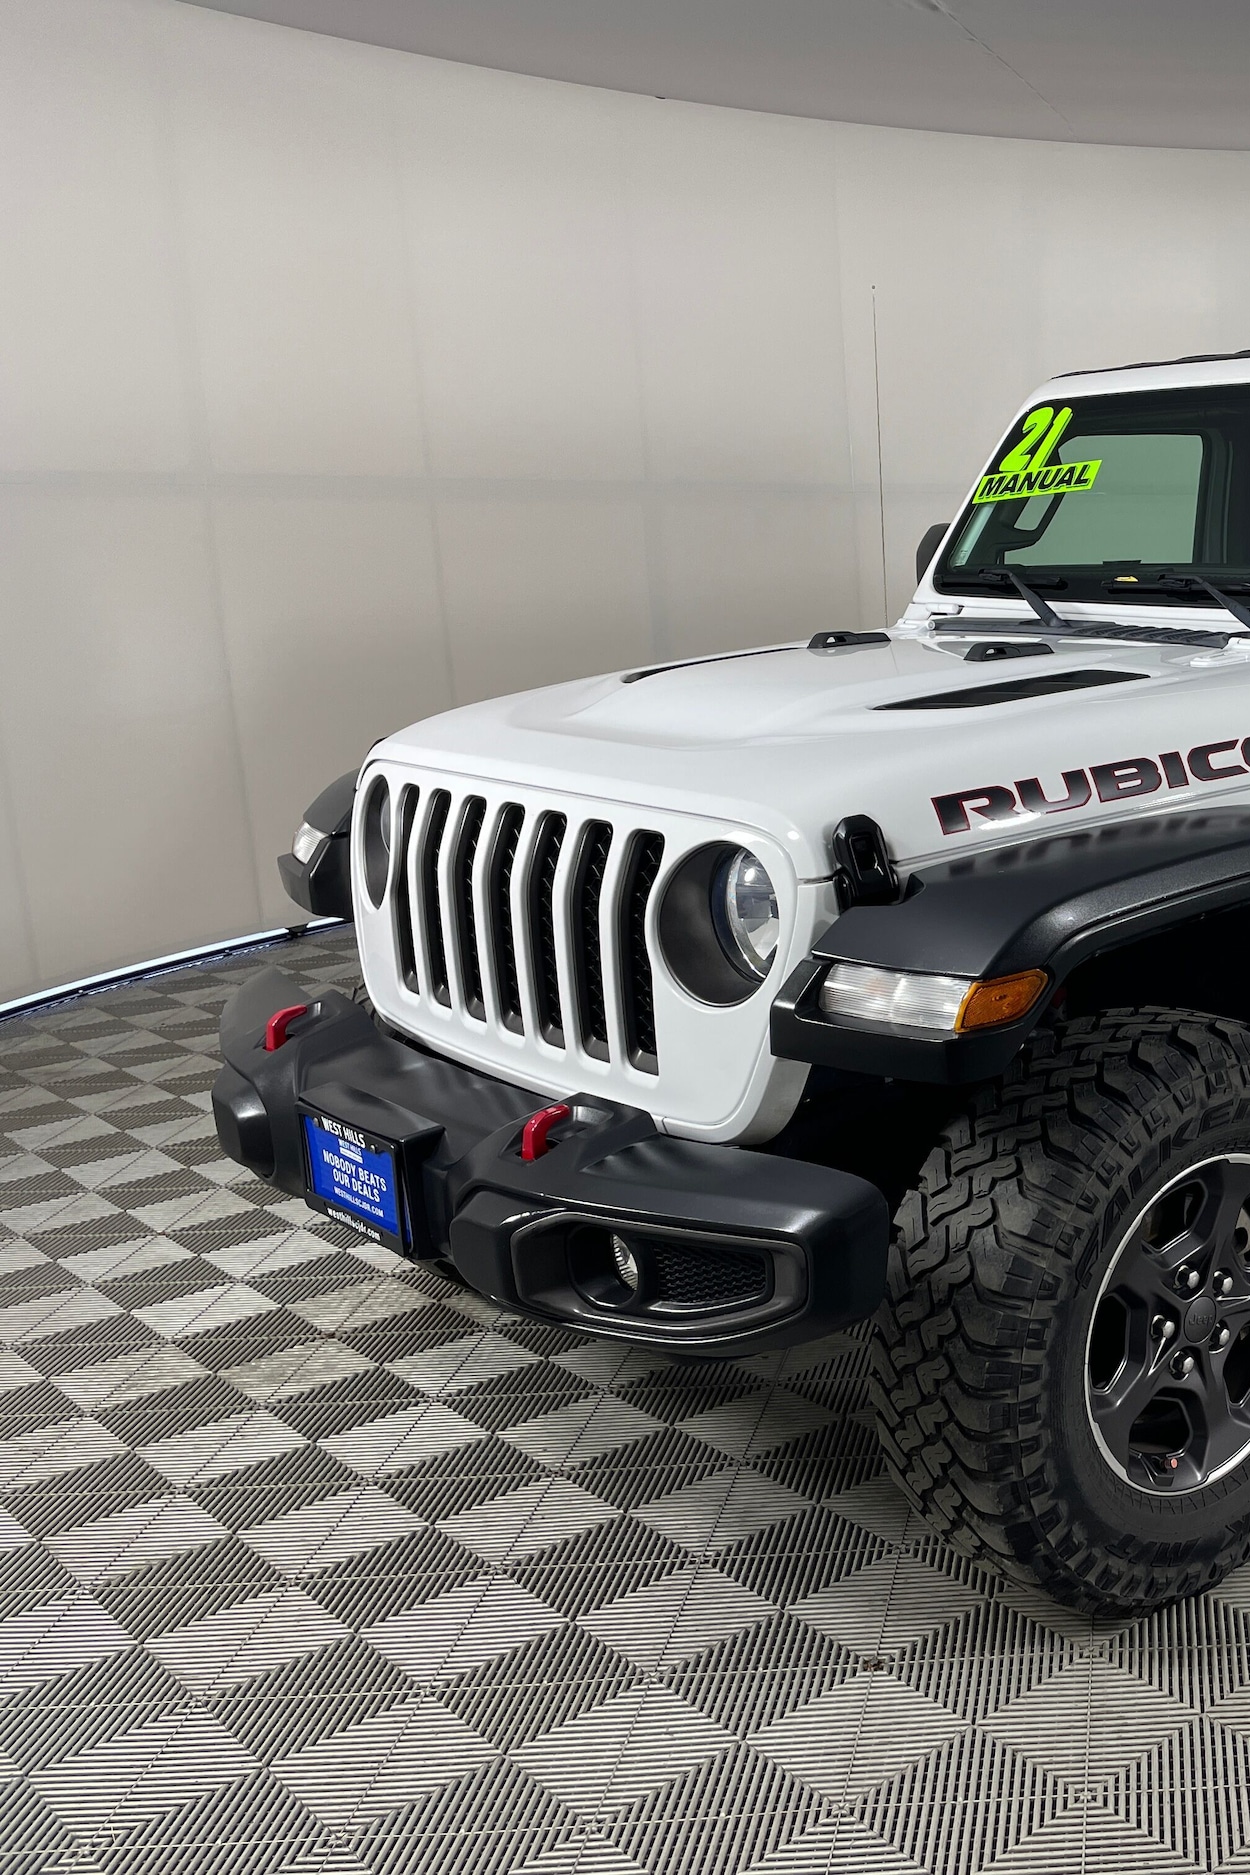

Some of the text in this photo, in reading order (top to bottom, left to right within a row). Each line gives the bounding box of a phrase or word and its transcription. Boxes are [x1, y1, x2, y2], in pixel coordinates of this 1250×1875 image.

[999, 407, 1073, 471] 21
[978, 465, 1091, 499] MANUAL
[321, 1116, 366, 1148] WEST HILLS
[323, 1149, 356, 1177] NOBODY
[358, 1167, 387, 1191] BEATS
[333, 1168, 380, 1202] OUR DEALS
